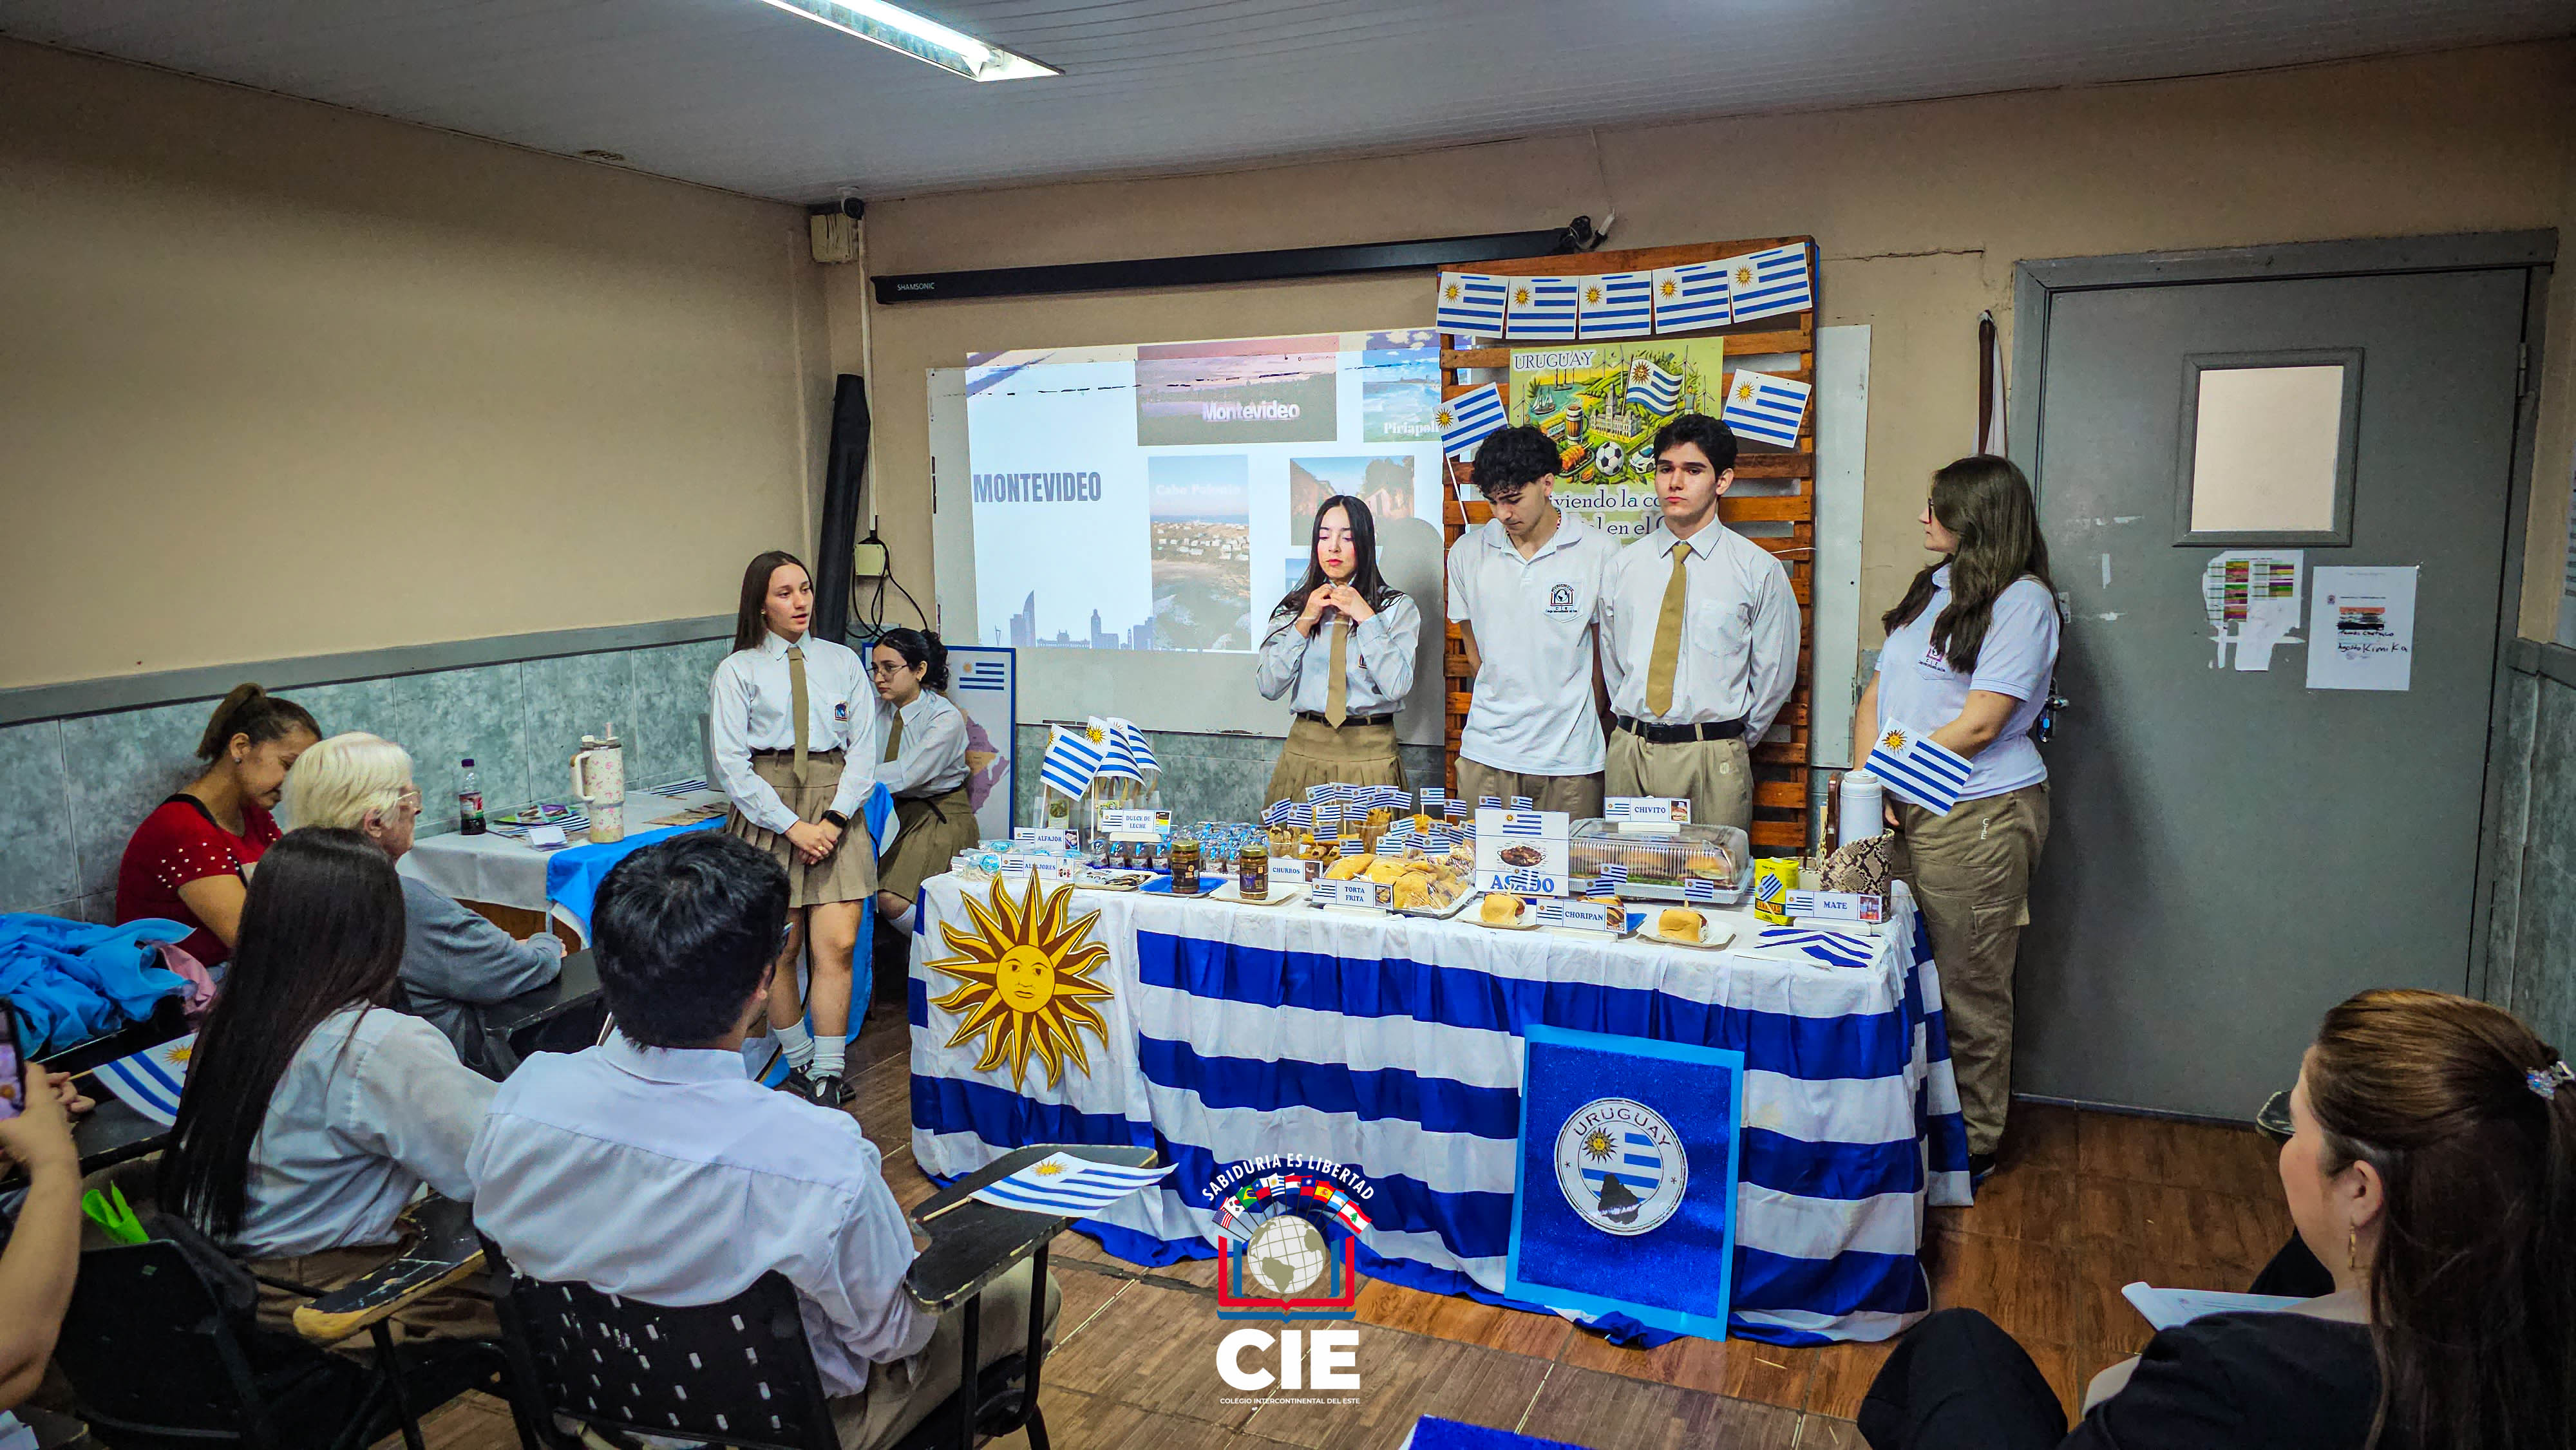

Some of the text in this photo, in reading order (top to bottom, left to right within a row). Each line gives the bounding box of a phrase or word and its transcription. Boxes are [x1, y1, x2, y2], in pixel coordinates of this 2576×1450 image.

[897, 282, 935, 291] SHAMSONIC
[1514, 351, 1594, 370] URUGUAY
[1204, 400, 1300, 422] Montevideo
[1385, 420, 1438, 437] Piriapoli
[973, 472, 1101, 502] MONTEVIDEO
[1549, 489, 1616, 508] iviendo
[1621, 489, 1638, 507] la
[1607, 525, 1629, 534] en
[1634, 516, 1650, 534] el
[1824, 901, 1847, 909] MATE
[1564, 910, 1604, 921] CHORIPAN
[1573, 1107, 1671, 1145] URUGUAY
